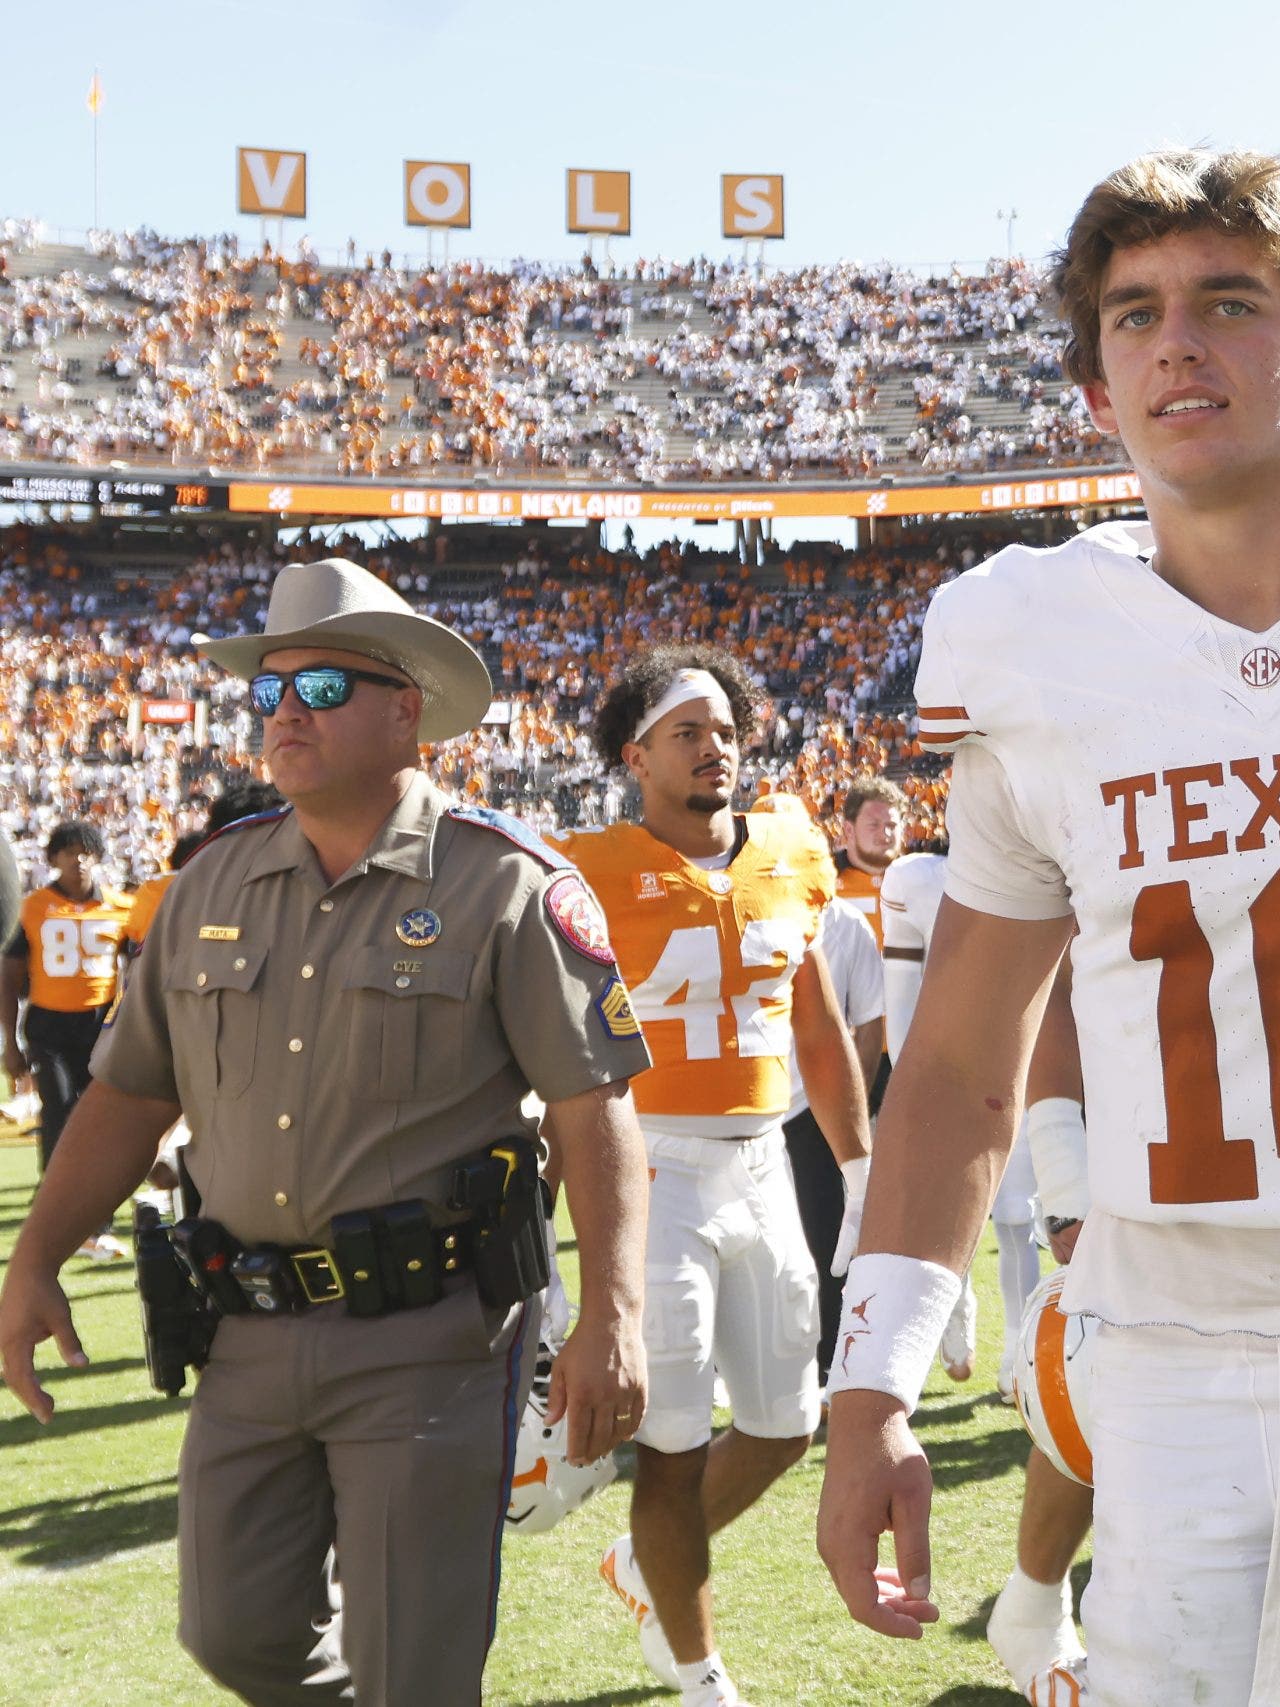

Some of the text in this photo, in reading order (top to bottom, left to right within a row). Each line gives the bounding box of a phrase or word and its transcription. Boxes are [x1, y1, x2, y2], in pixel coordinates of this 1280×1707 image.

[28, 477, 93, 493] MISSOURI
[142, 483, 165, 497] PM
[521, 494, 643, 517] NEYLAND
[1242, 648, 1280, 686] SEC
[40, 918, 119, 978] 85
[628, 922, 806, 1060] 42
